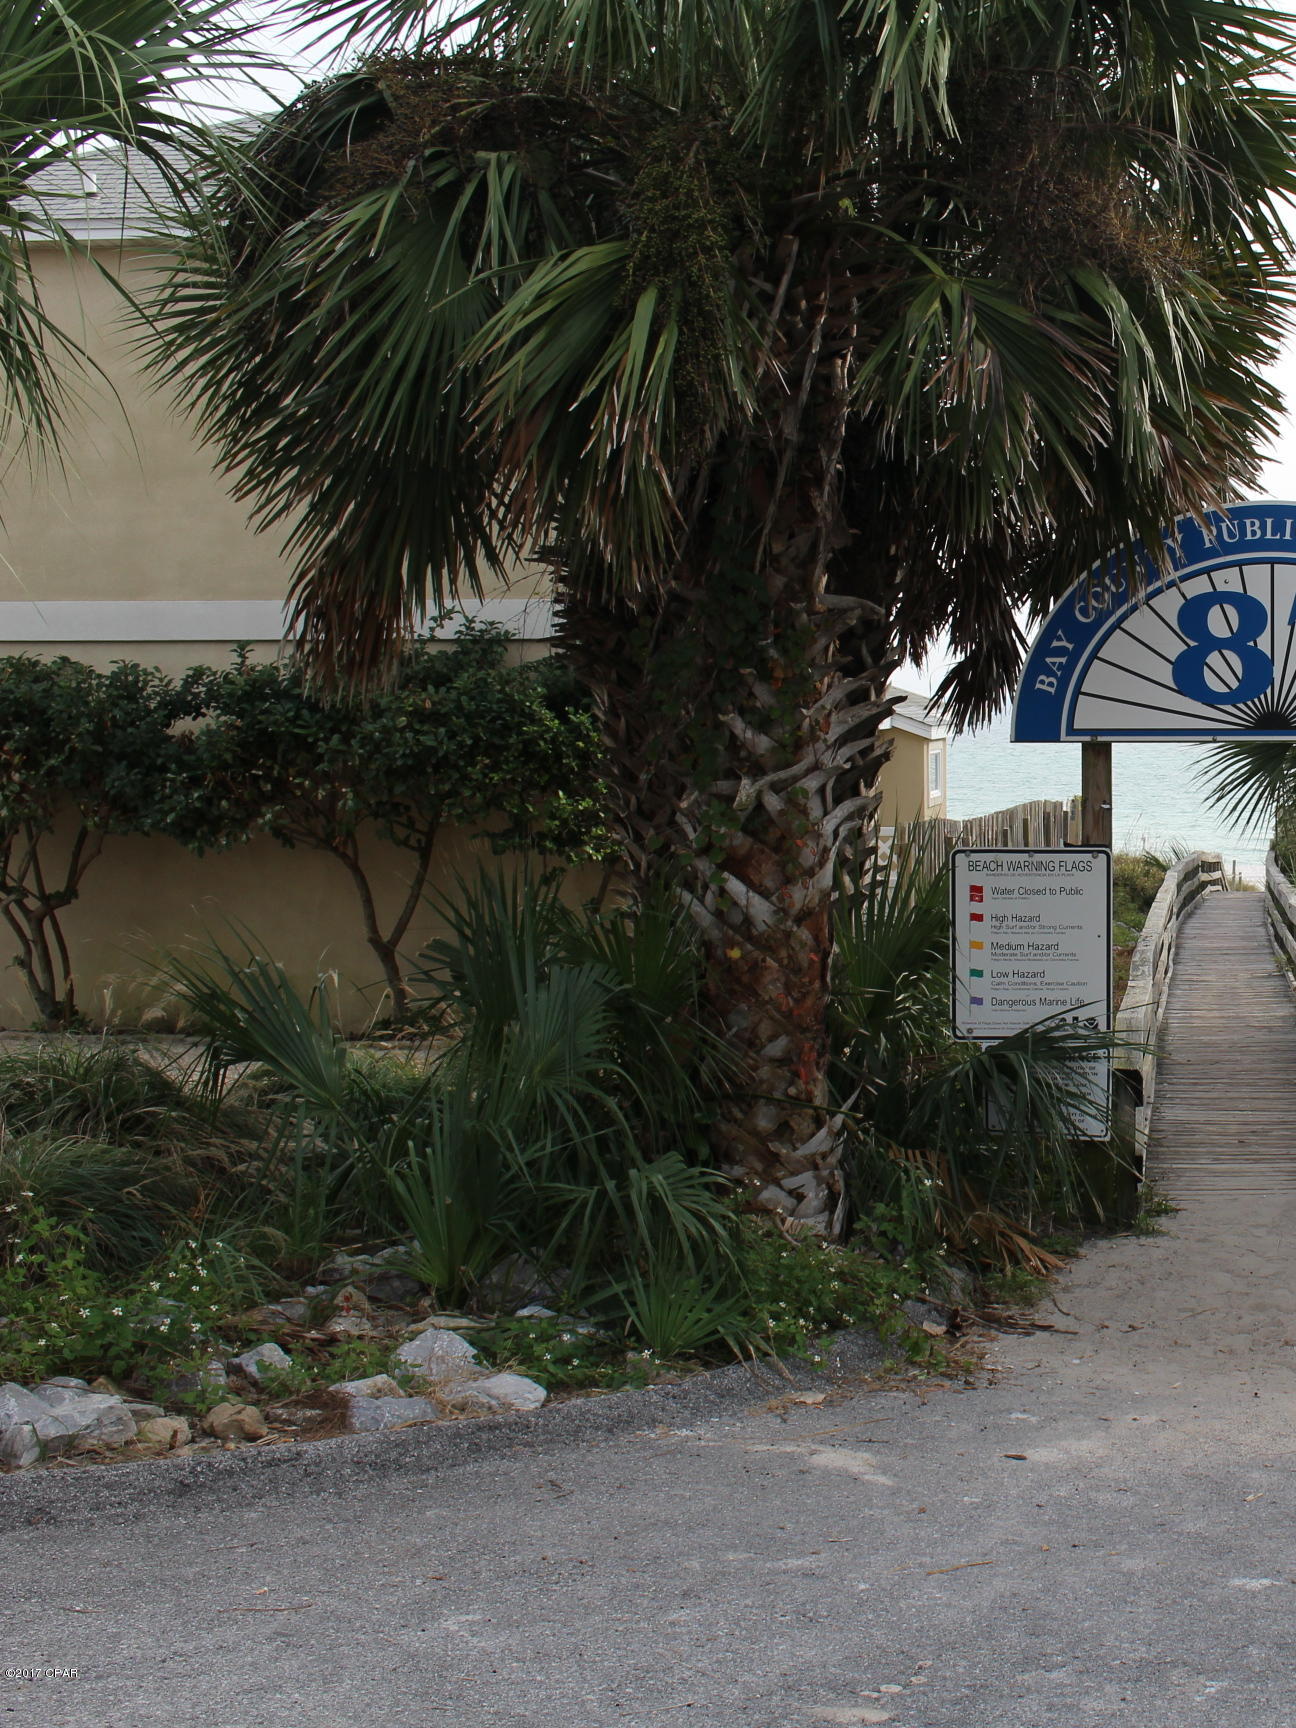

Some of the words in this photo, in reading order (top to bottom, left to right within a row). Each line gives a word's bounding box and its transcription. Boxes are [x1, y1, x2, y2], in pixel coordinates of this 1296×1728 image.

[1034, 631, 1077, 696] BAY
[968, 860, 1004, 872] BEACH
[1006, 860, 1056, 872] WARNING
[1058, 860, 1093, 872] FLAGS
[991, 886, 1016, 896] Water
[1018, 886, 1047, 896] Closed
[1049, 886, 1057, 896] to
[1059, 886, 1084, 896] Public
[990, 914, 1009, 925] High
[1011, 913, 1041, 923] Hazard
[991, 941, 1025, 951] Medium
[1027, 941, 1060, 951] Hazard
[991, 969, 1010, 979] Low
[1012, 969, 1046, 979] Hazard
[991, 997, 1037, 1009] Dangerous
[1039, 997, 1068, 1007] Marine
[1069, 997, 1085, 1007] Life
